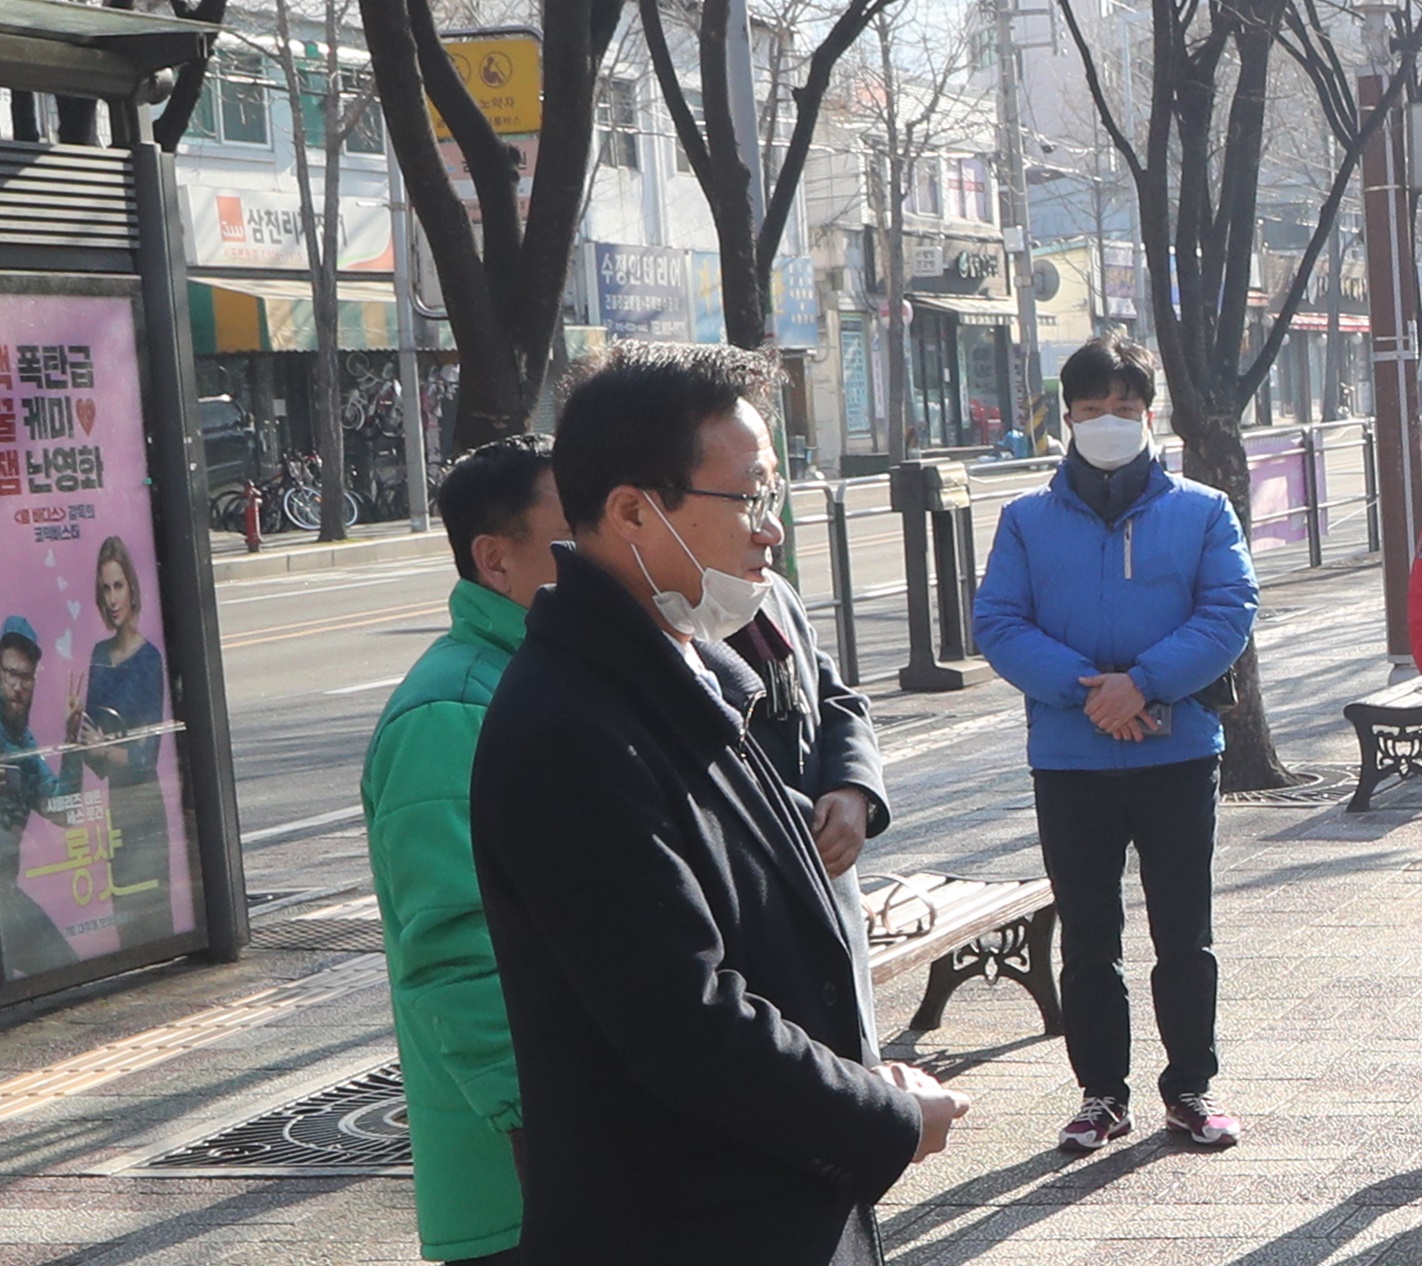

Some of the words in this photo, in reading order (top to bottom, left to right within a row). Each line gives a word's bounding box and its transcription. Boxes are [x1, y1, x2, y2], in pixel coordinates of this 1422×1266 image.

[601, 252, 682, 288] 수정인테리어
[17, 344, 94, 389] 폭탄급
[22, 396, 75, 440] 케미
[26, 446, 104, 494] 난영화
